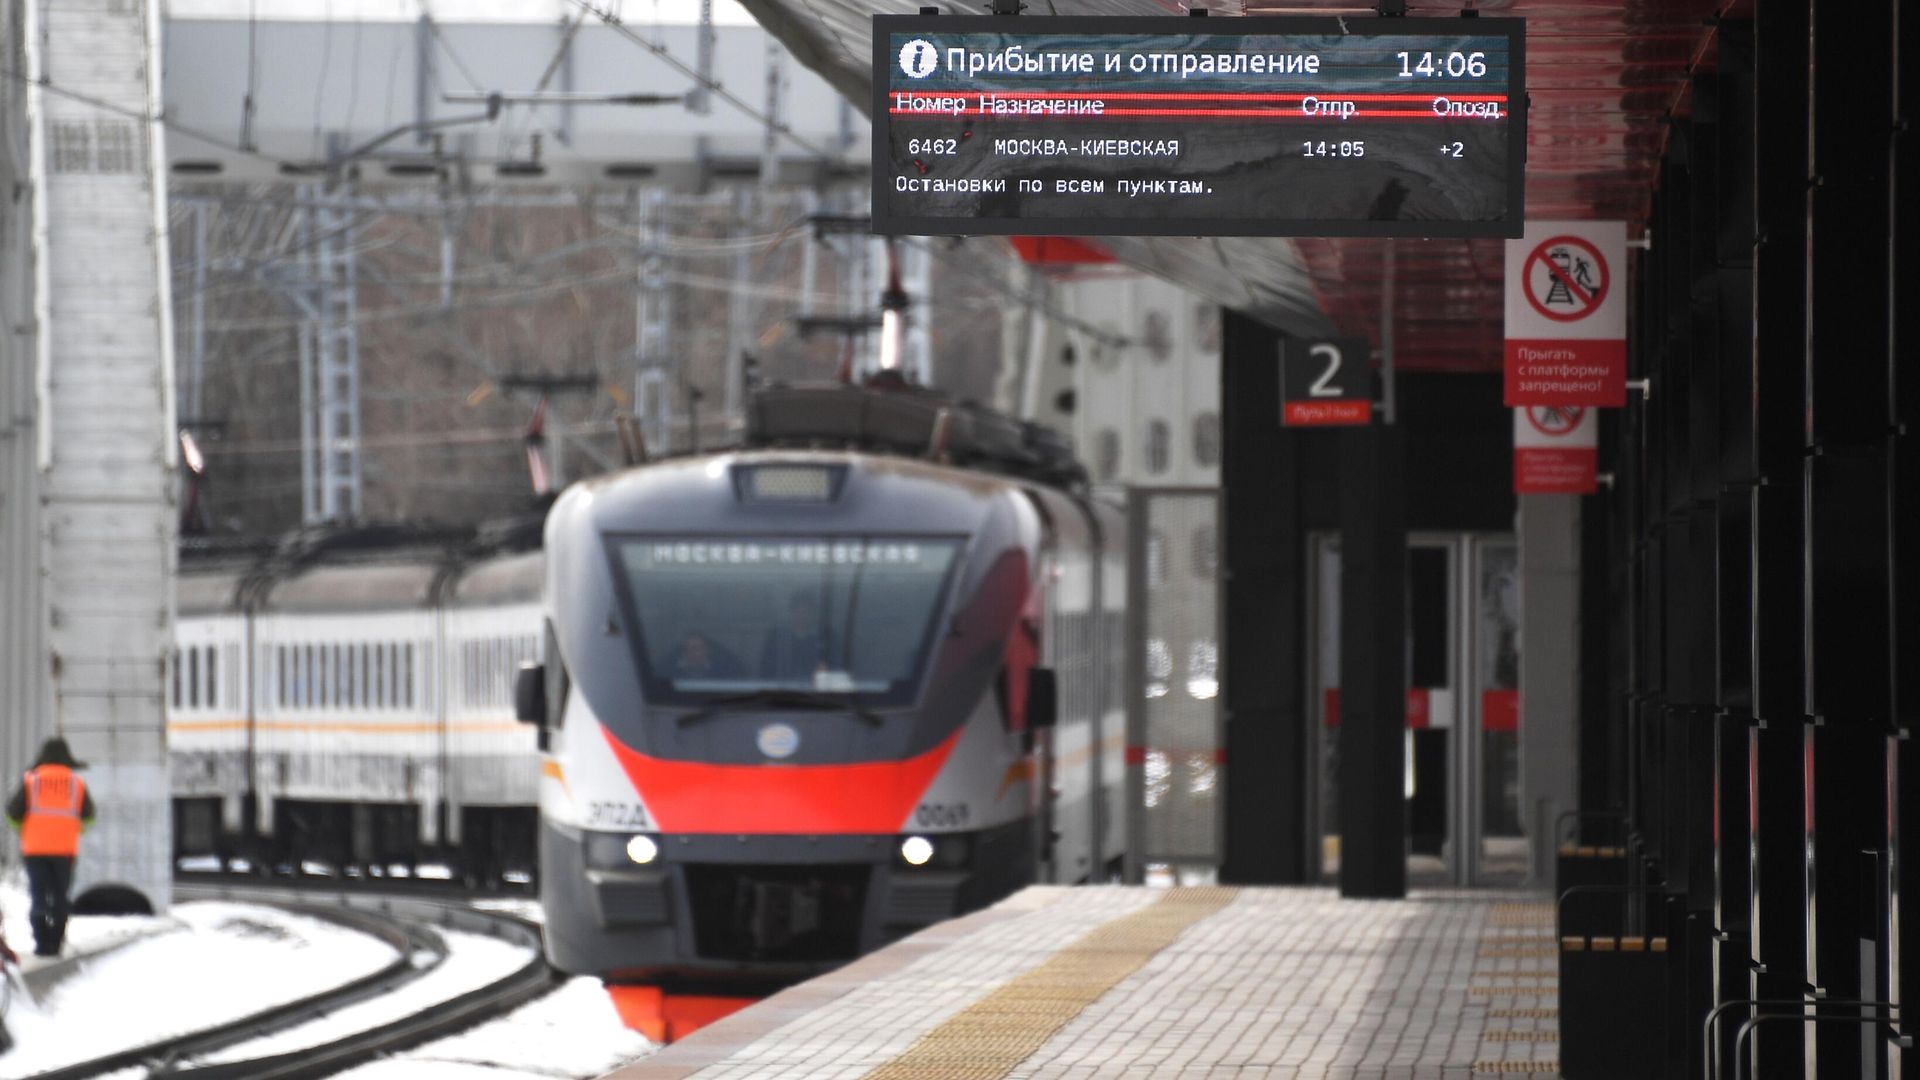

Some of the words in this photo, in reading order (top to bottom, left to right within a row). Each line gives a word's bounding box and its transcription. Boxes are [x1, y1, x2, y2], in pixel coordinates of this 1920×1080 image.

[947, 45, 1094, 78] Прибытие
[1104, 53, 1121, 73] и
[1129, 53, 1320, 79] отправление
[1397, 51, 1486, 77] 14:06
[896, 92, 966, 116] Номер
[979, 93, 1105, 115] Назначение
[1302, 95, 1360, 120] Отпр.
[1432, 96, 1504, 120] Опозд.
[908, 138, 957, 155] 6462
[994, 139, 1179, 156] МОСКВА-КИЕВСКАЯ
[1303, 141, 1364, 157] 14:05
[1440, 141, 1464, 158] +2
[896, 175, 1006, 193] Остановки
[1019, 179, 1043, 193] по
[1056, 179, 1104, 193] всем
[1117, 180, 1212, 198] пунктам.
[1518, 347, 1576, 362] Прыгать
[1309, 343, 1343, 397] 2
[1518, 365, 1526, 376] с
[1528, 364, 1609, 378] платформы
